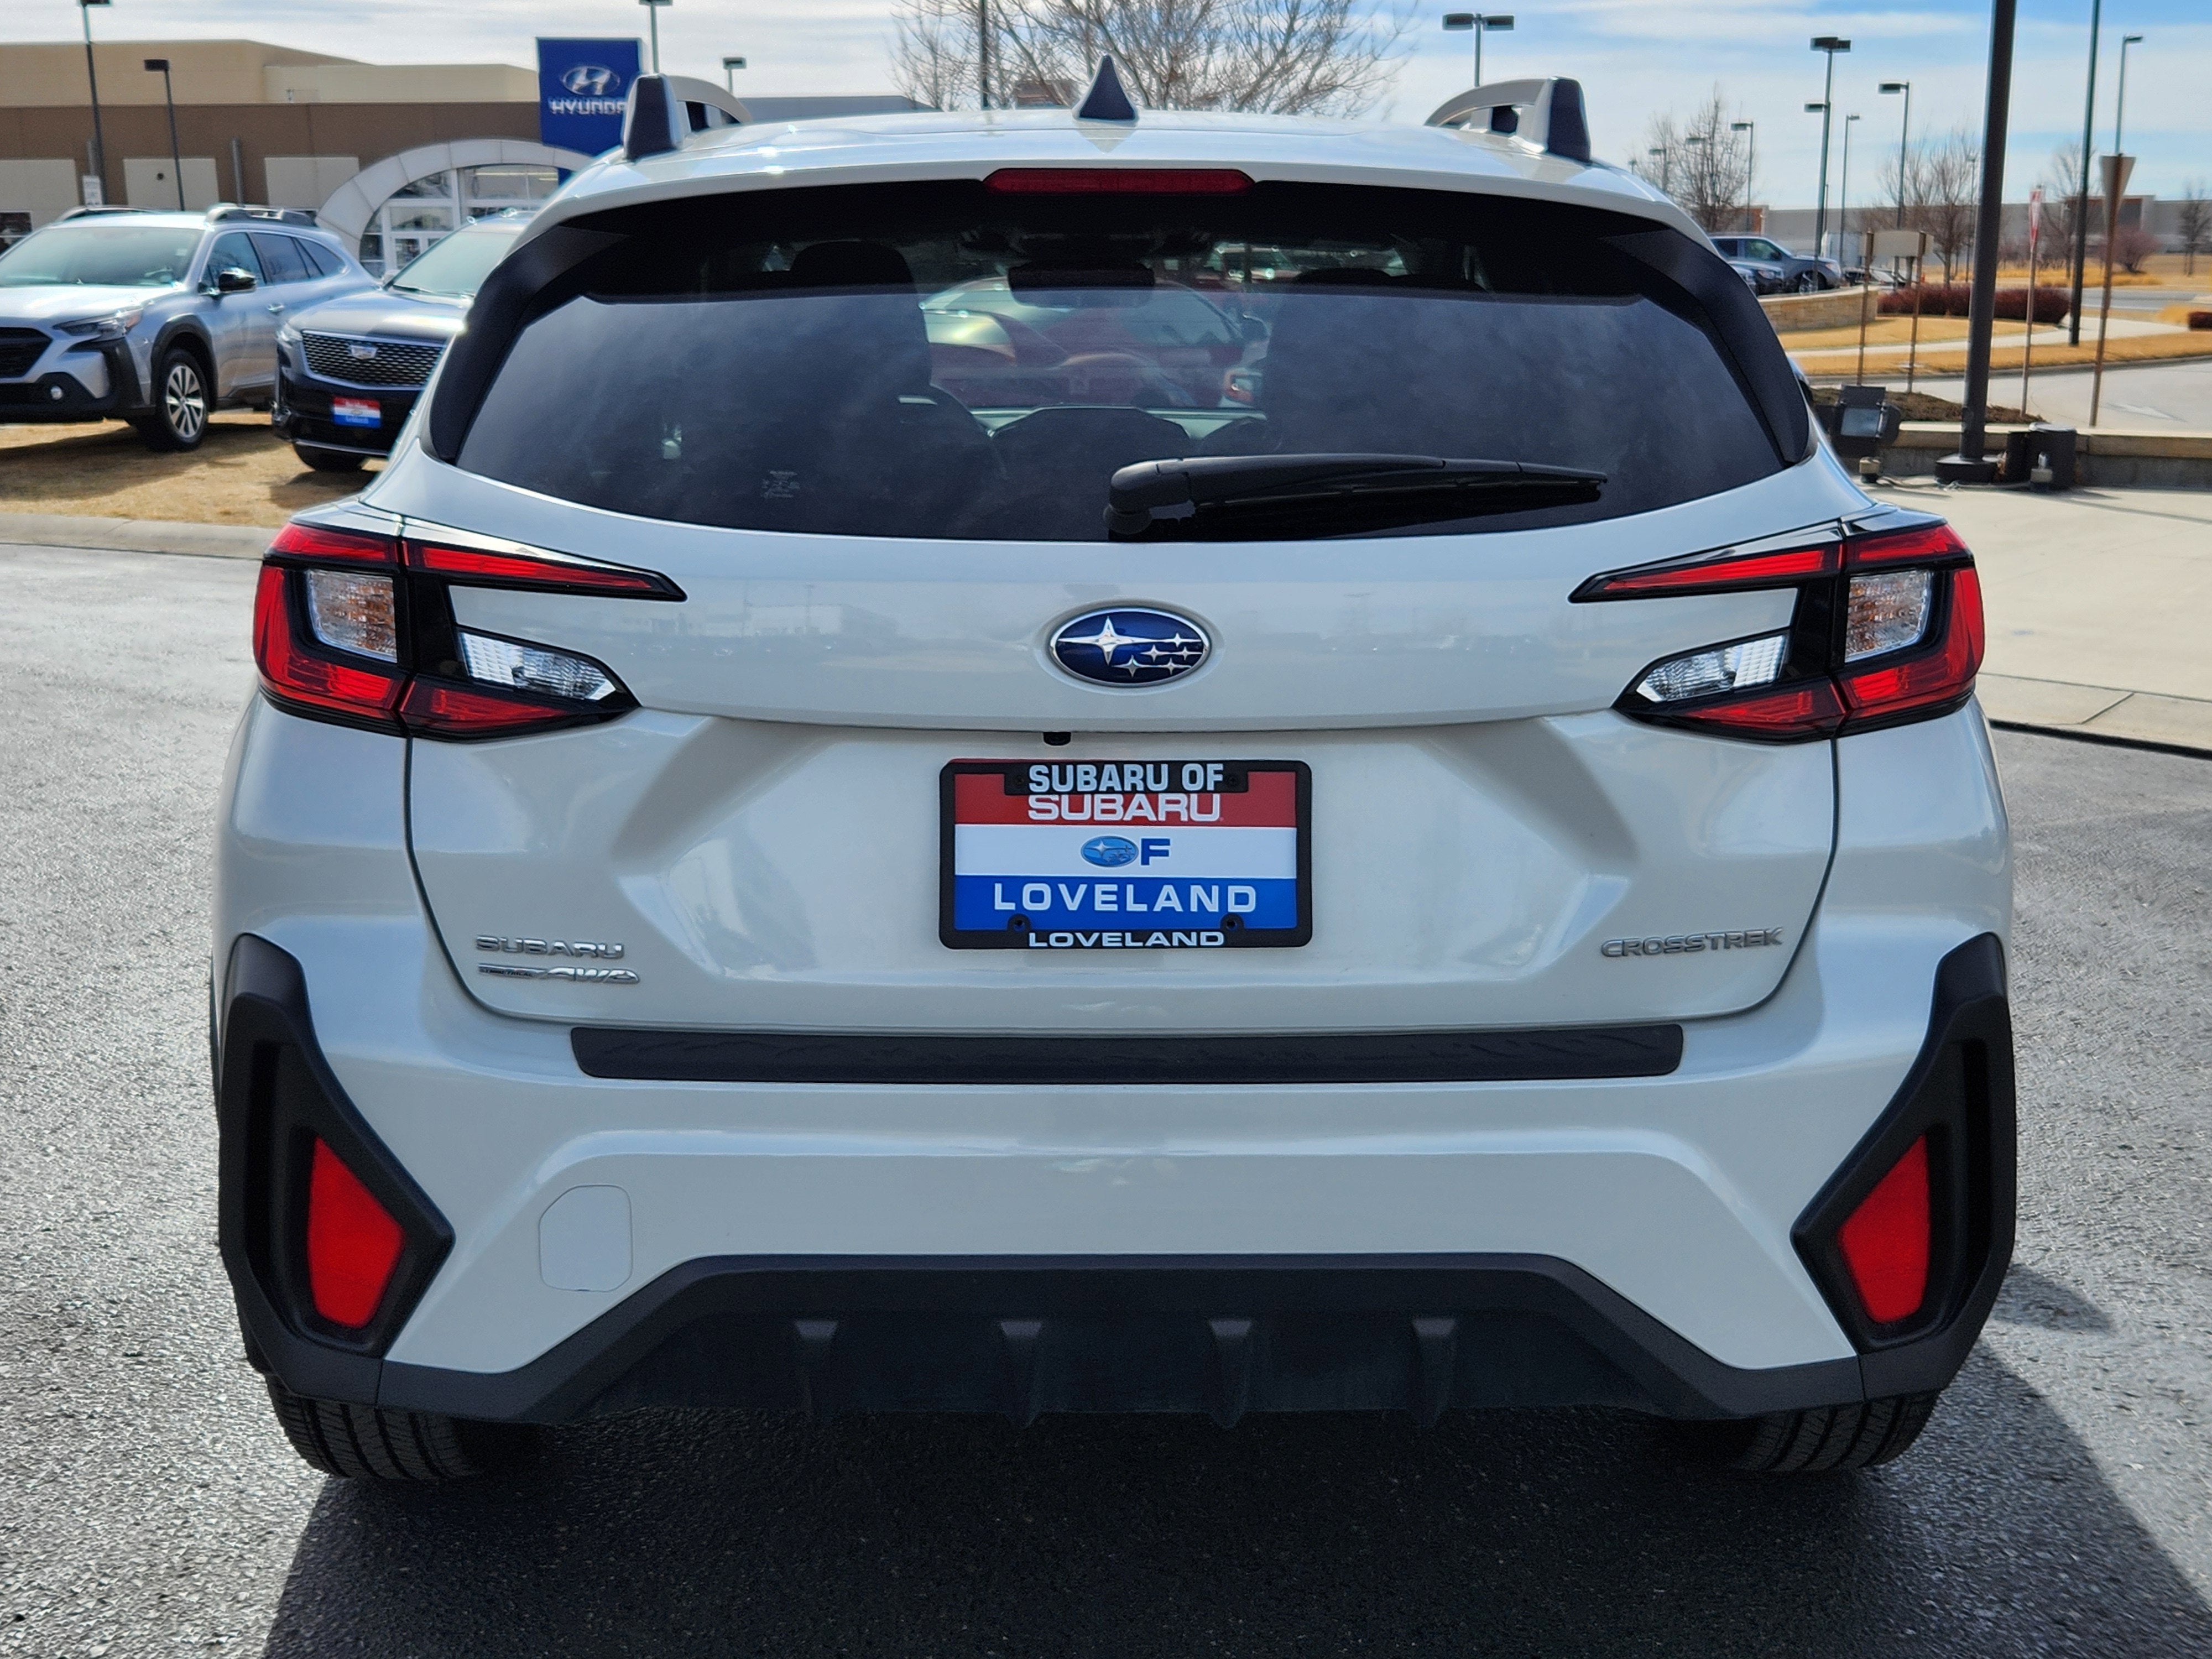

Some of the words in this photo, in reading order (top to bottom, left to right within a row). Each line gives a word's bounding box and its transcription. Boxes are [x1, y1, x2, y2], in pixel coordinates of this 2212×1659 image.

[549, 99, 625, 114] HYUNDA
[1029, 763, 1168, 792] SUBARU
[1182, 763, 1224, 791] OF
[1027, 793, 1220, 822] SUBARU
[994, 883, 1256, 913] LOVELAND
[476, 934, 624, 959] SUBARU
[1029, 932, 1225, 947] LOVELAND
[1600, 926, 1783, 957] CROSSTREK
[546, 966, 640, 984] AWD
